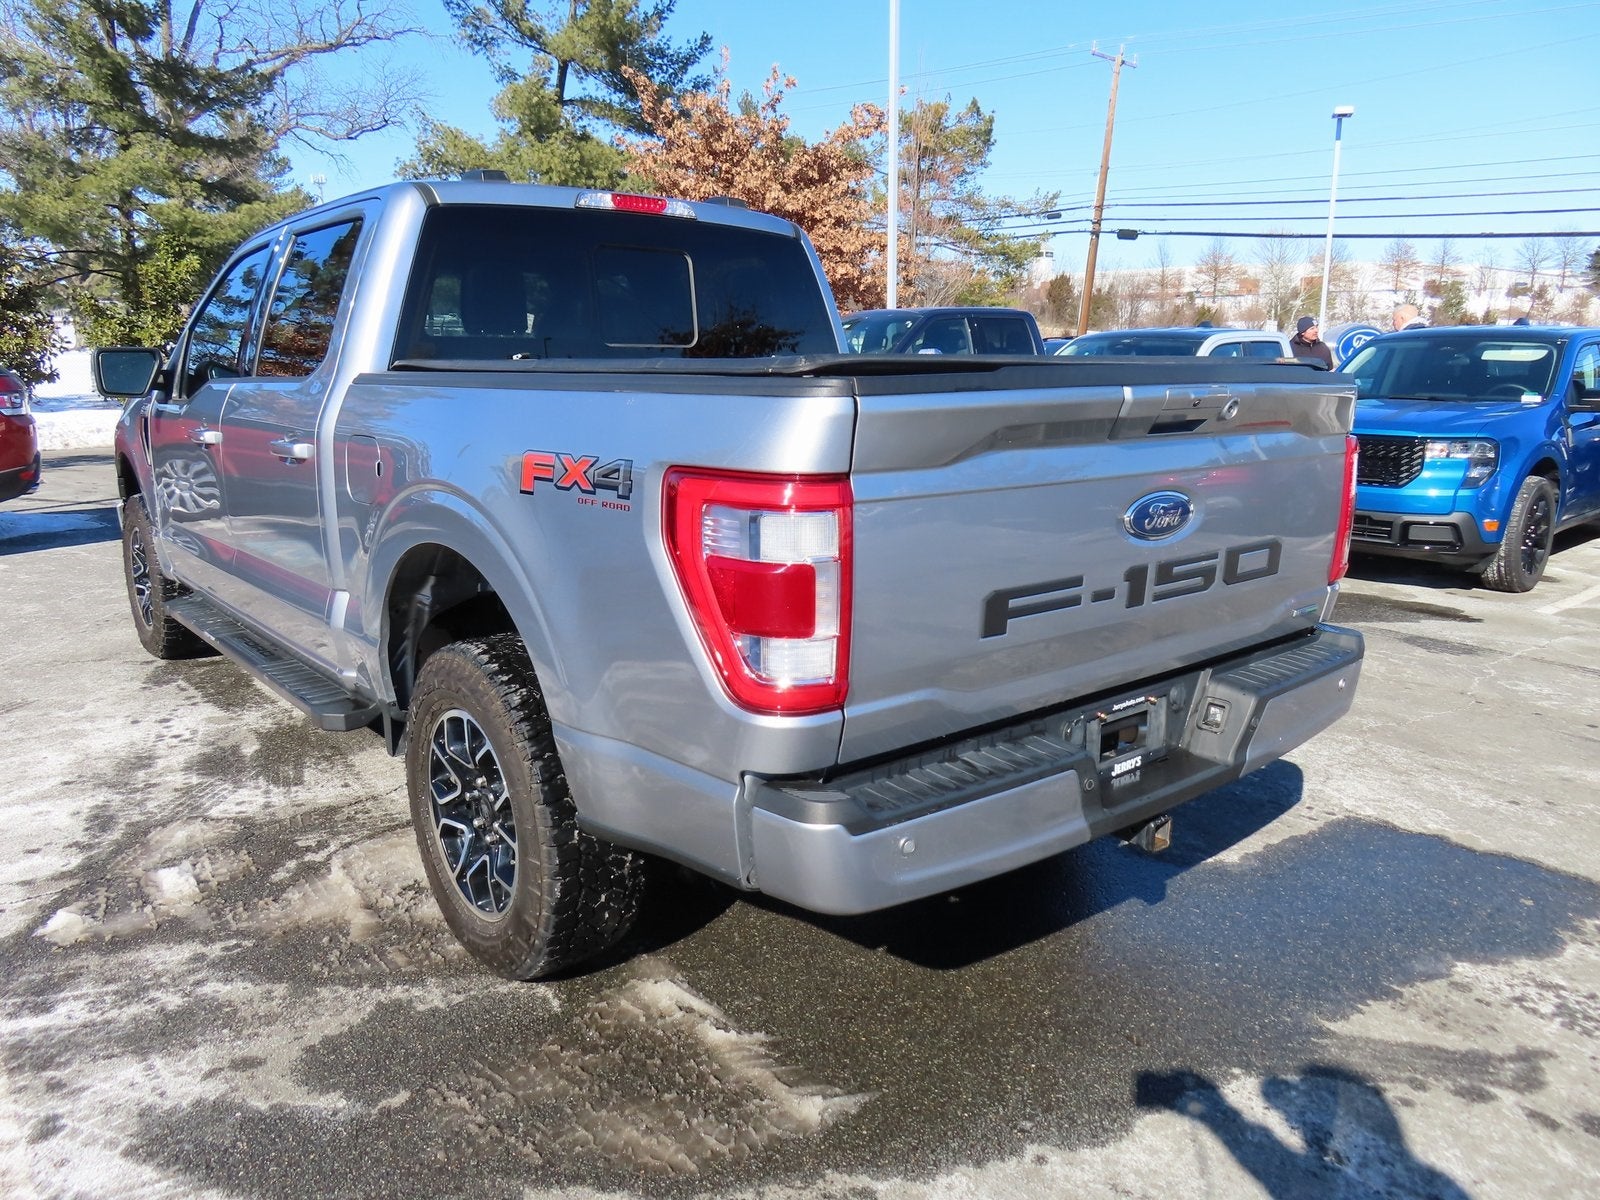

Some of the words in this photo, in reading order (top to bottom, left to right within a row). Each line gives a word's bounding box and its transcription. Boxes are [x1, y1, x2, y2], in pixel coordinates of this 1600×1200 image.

[520, 449, 633, 500] FX4
[577, 497, 598, 507] OFF
[601, 501, 631, 512] ROAD
[1144, 502, 1183, 530] Ford
[980, 537, 1282, 639] F-150
[1111, 756, 1142, 777] JERRY'S
